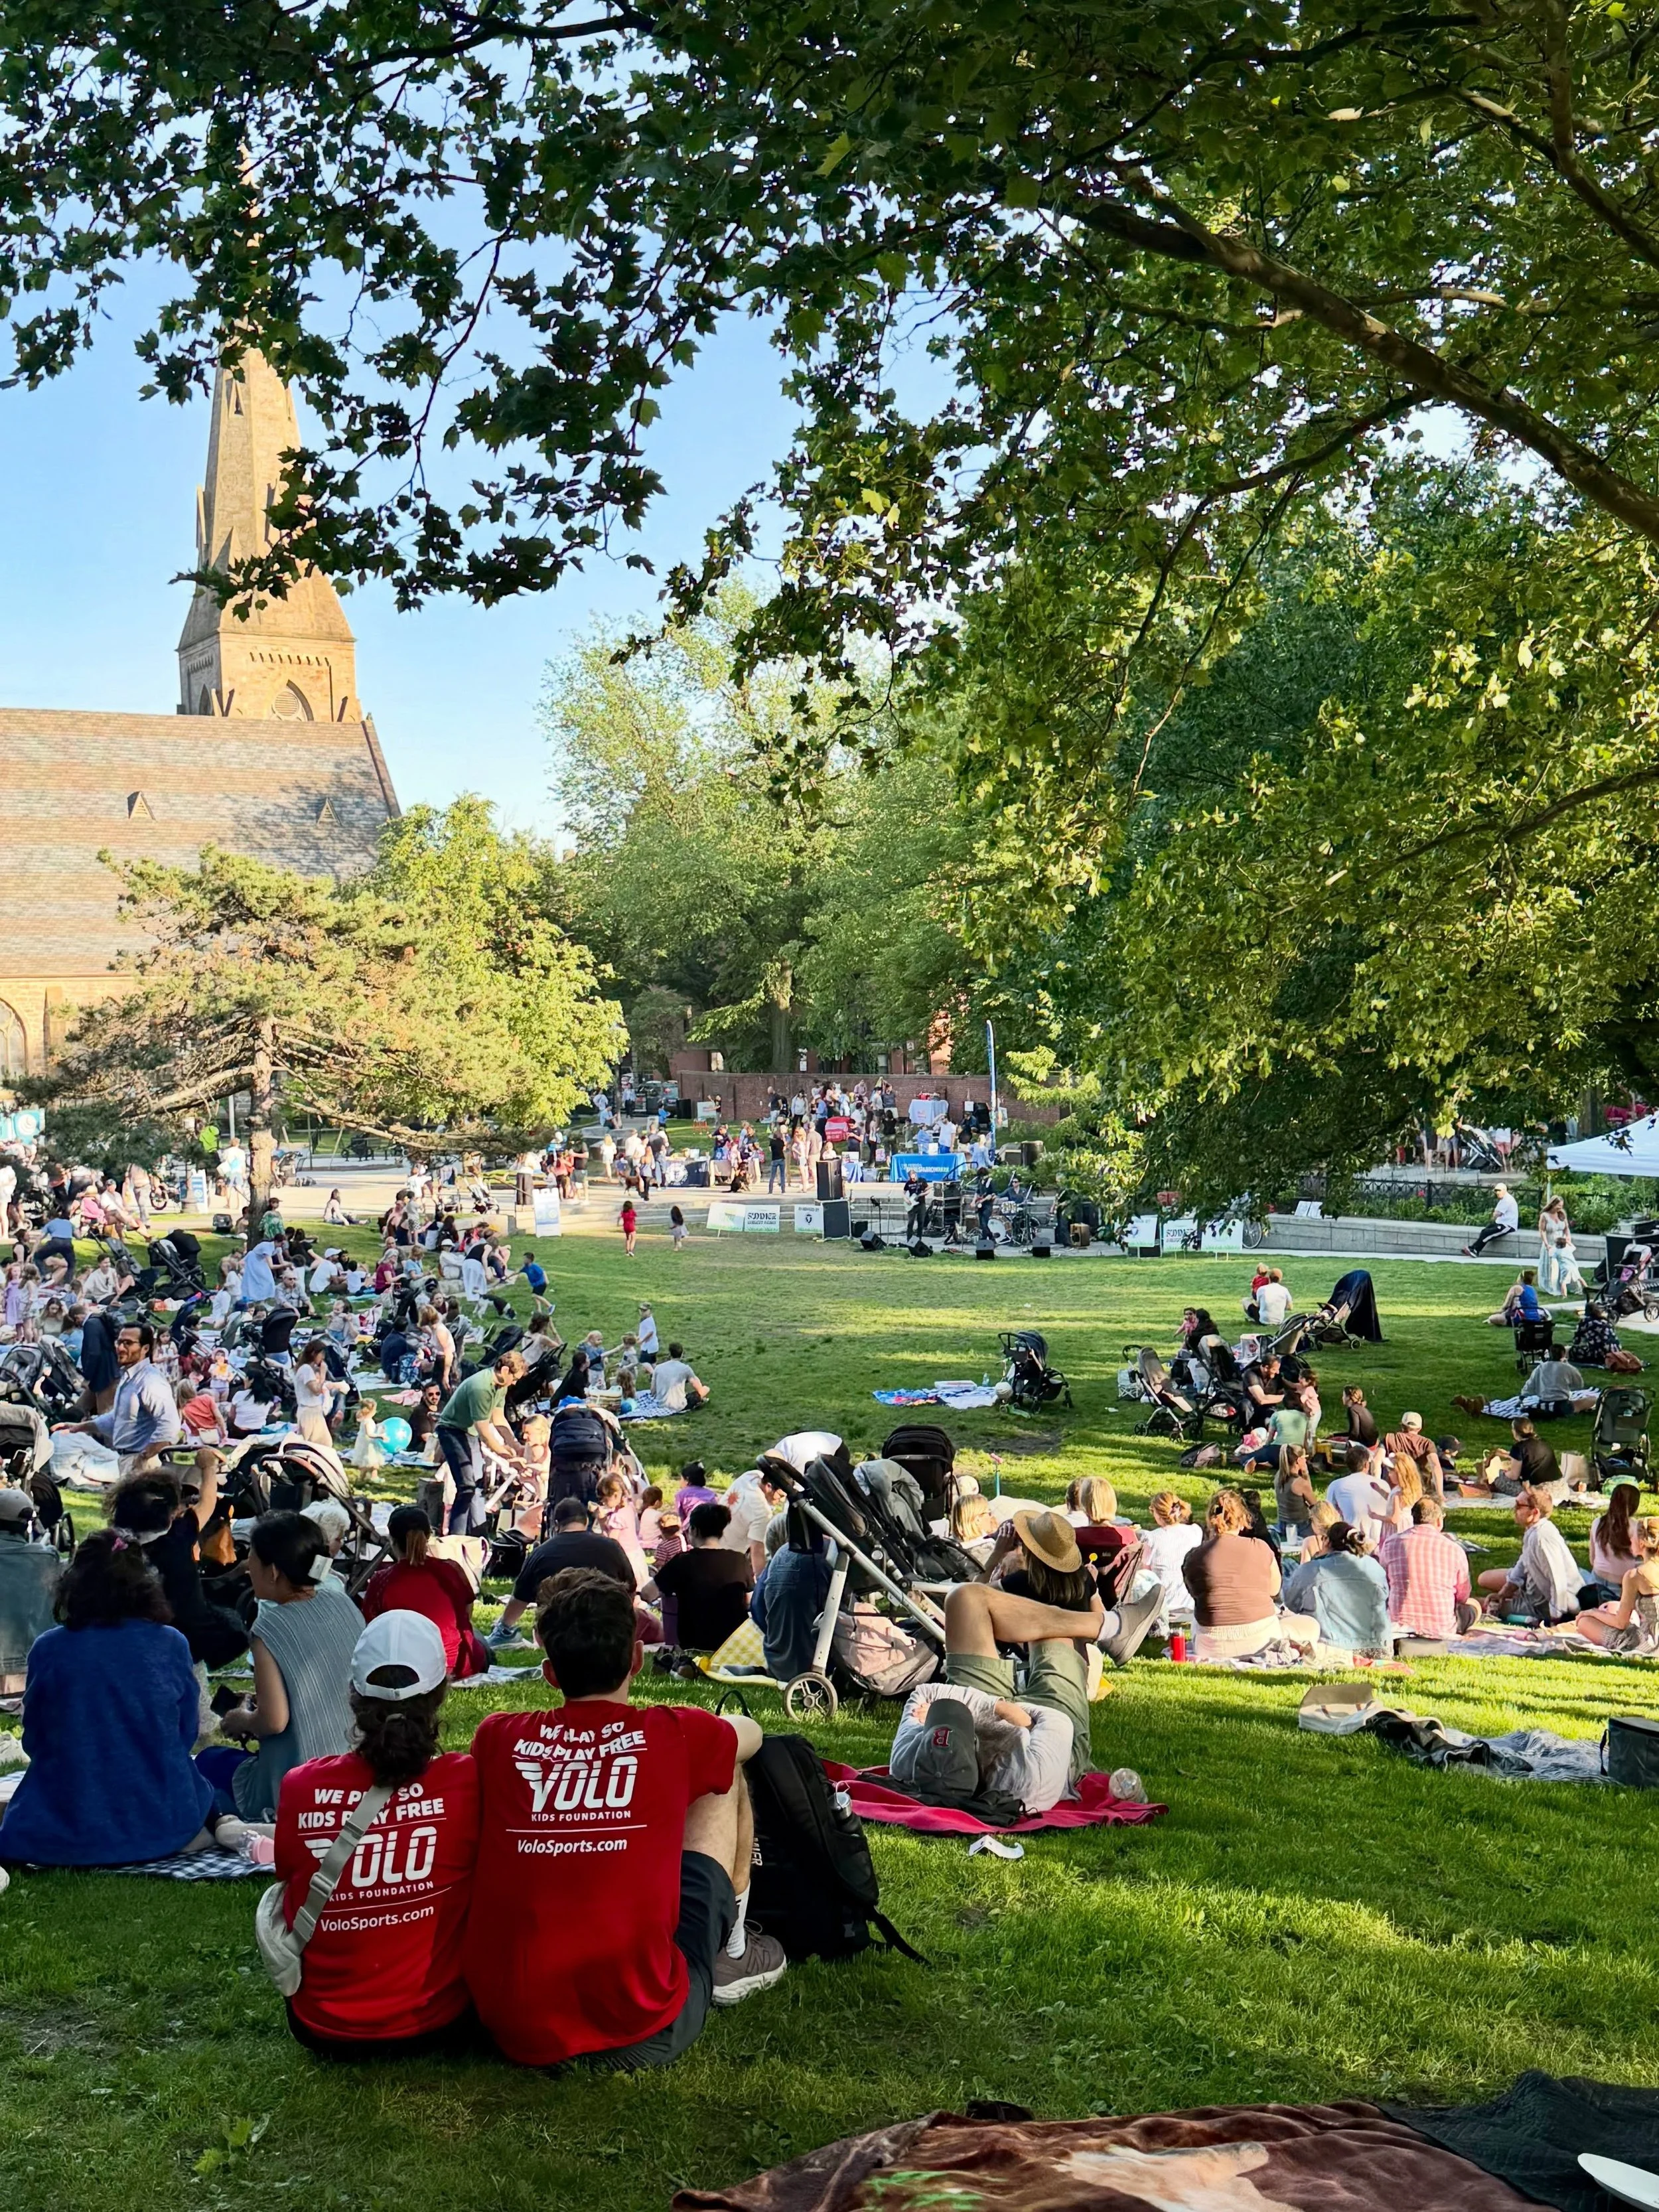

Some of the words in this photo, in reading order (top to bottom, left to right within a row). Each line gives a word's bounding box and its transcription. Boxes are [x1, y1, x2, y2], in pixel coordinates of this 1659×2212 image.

[540, 1724, 563, 1740] WE
[601, 1721, 624, 1738] SO
[514, 1739, 553, 1759] KIDS
[553, 1744, 596, 1761] PLAY
[599, 1730, 646, 1757] FREE
[315, 1789, 344, 1804] WE
[398, 1783, 423, 1801] SO
[516, 1755, 638, 1812] VOLO
[299, 1811, 335, 1829] KIDS
[342, 1808, 390, 1826] PY
[396, 1798, 445, 1821] FREE
[559, 1810, 631, 1822] FOUNDATION
[518, 1839, 627, 1856] VoloSports.com
[329, 1891, 353, 1901] KIDS
[360, 1881, 434, 1899] FOUNDATION
[321, 1906, 434, 1931] VoloSports.com
